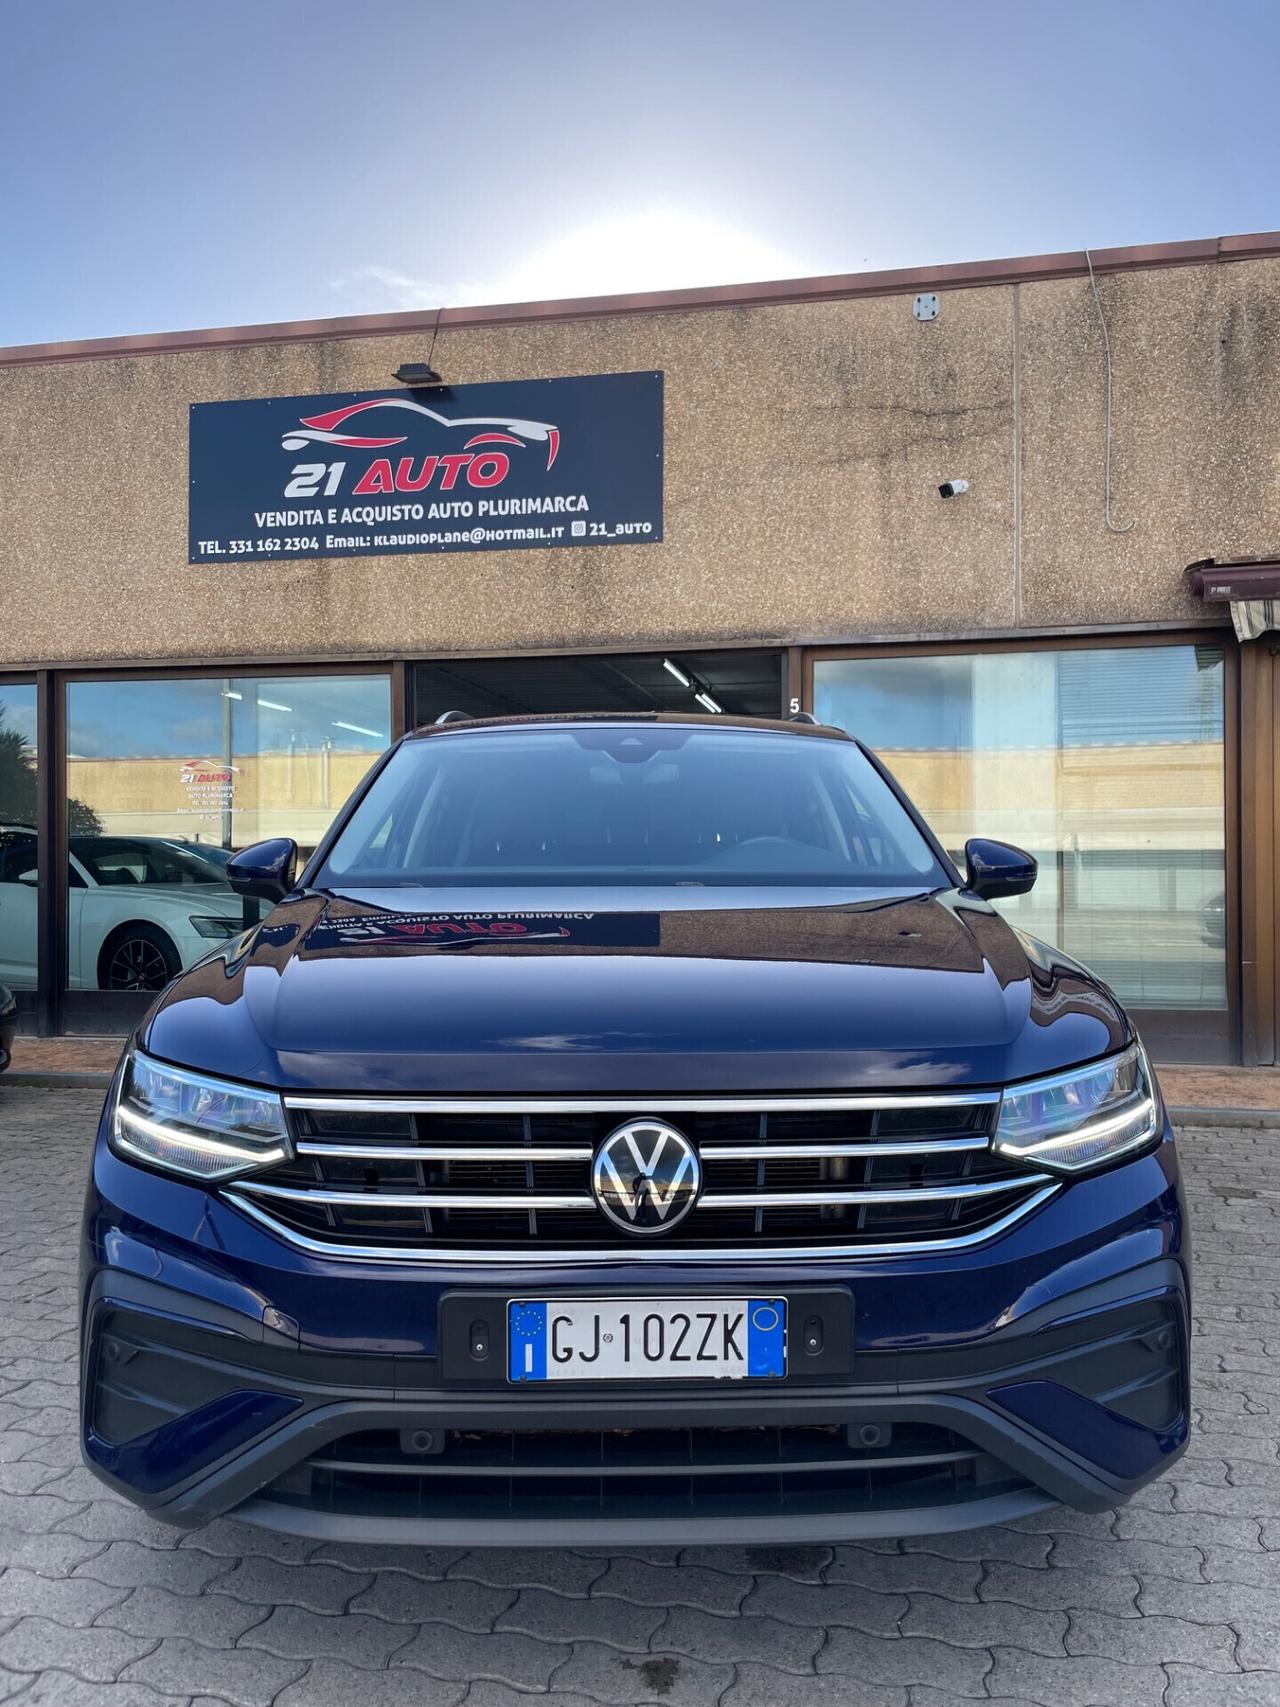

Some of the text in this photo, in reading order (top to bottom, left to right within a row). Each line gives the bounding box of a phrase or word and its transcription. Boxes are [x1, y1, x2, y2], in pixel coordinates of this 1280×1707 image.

[283, 452, 511, 498] 21 AUTO
[254, 495, 590, 528] VENDITA E ACQUISTO AUTO PLURIMARCA
[198, 540, 227, 555] TEL.
[229, 540, 254, 554] 331
[256, 538, 282, 552] 162
[284, 536, 320, 551] 2304
[789, 697, 800, 714] 5
